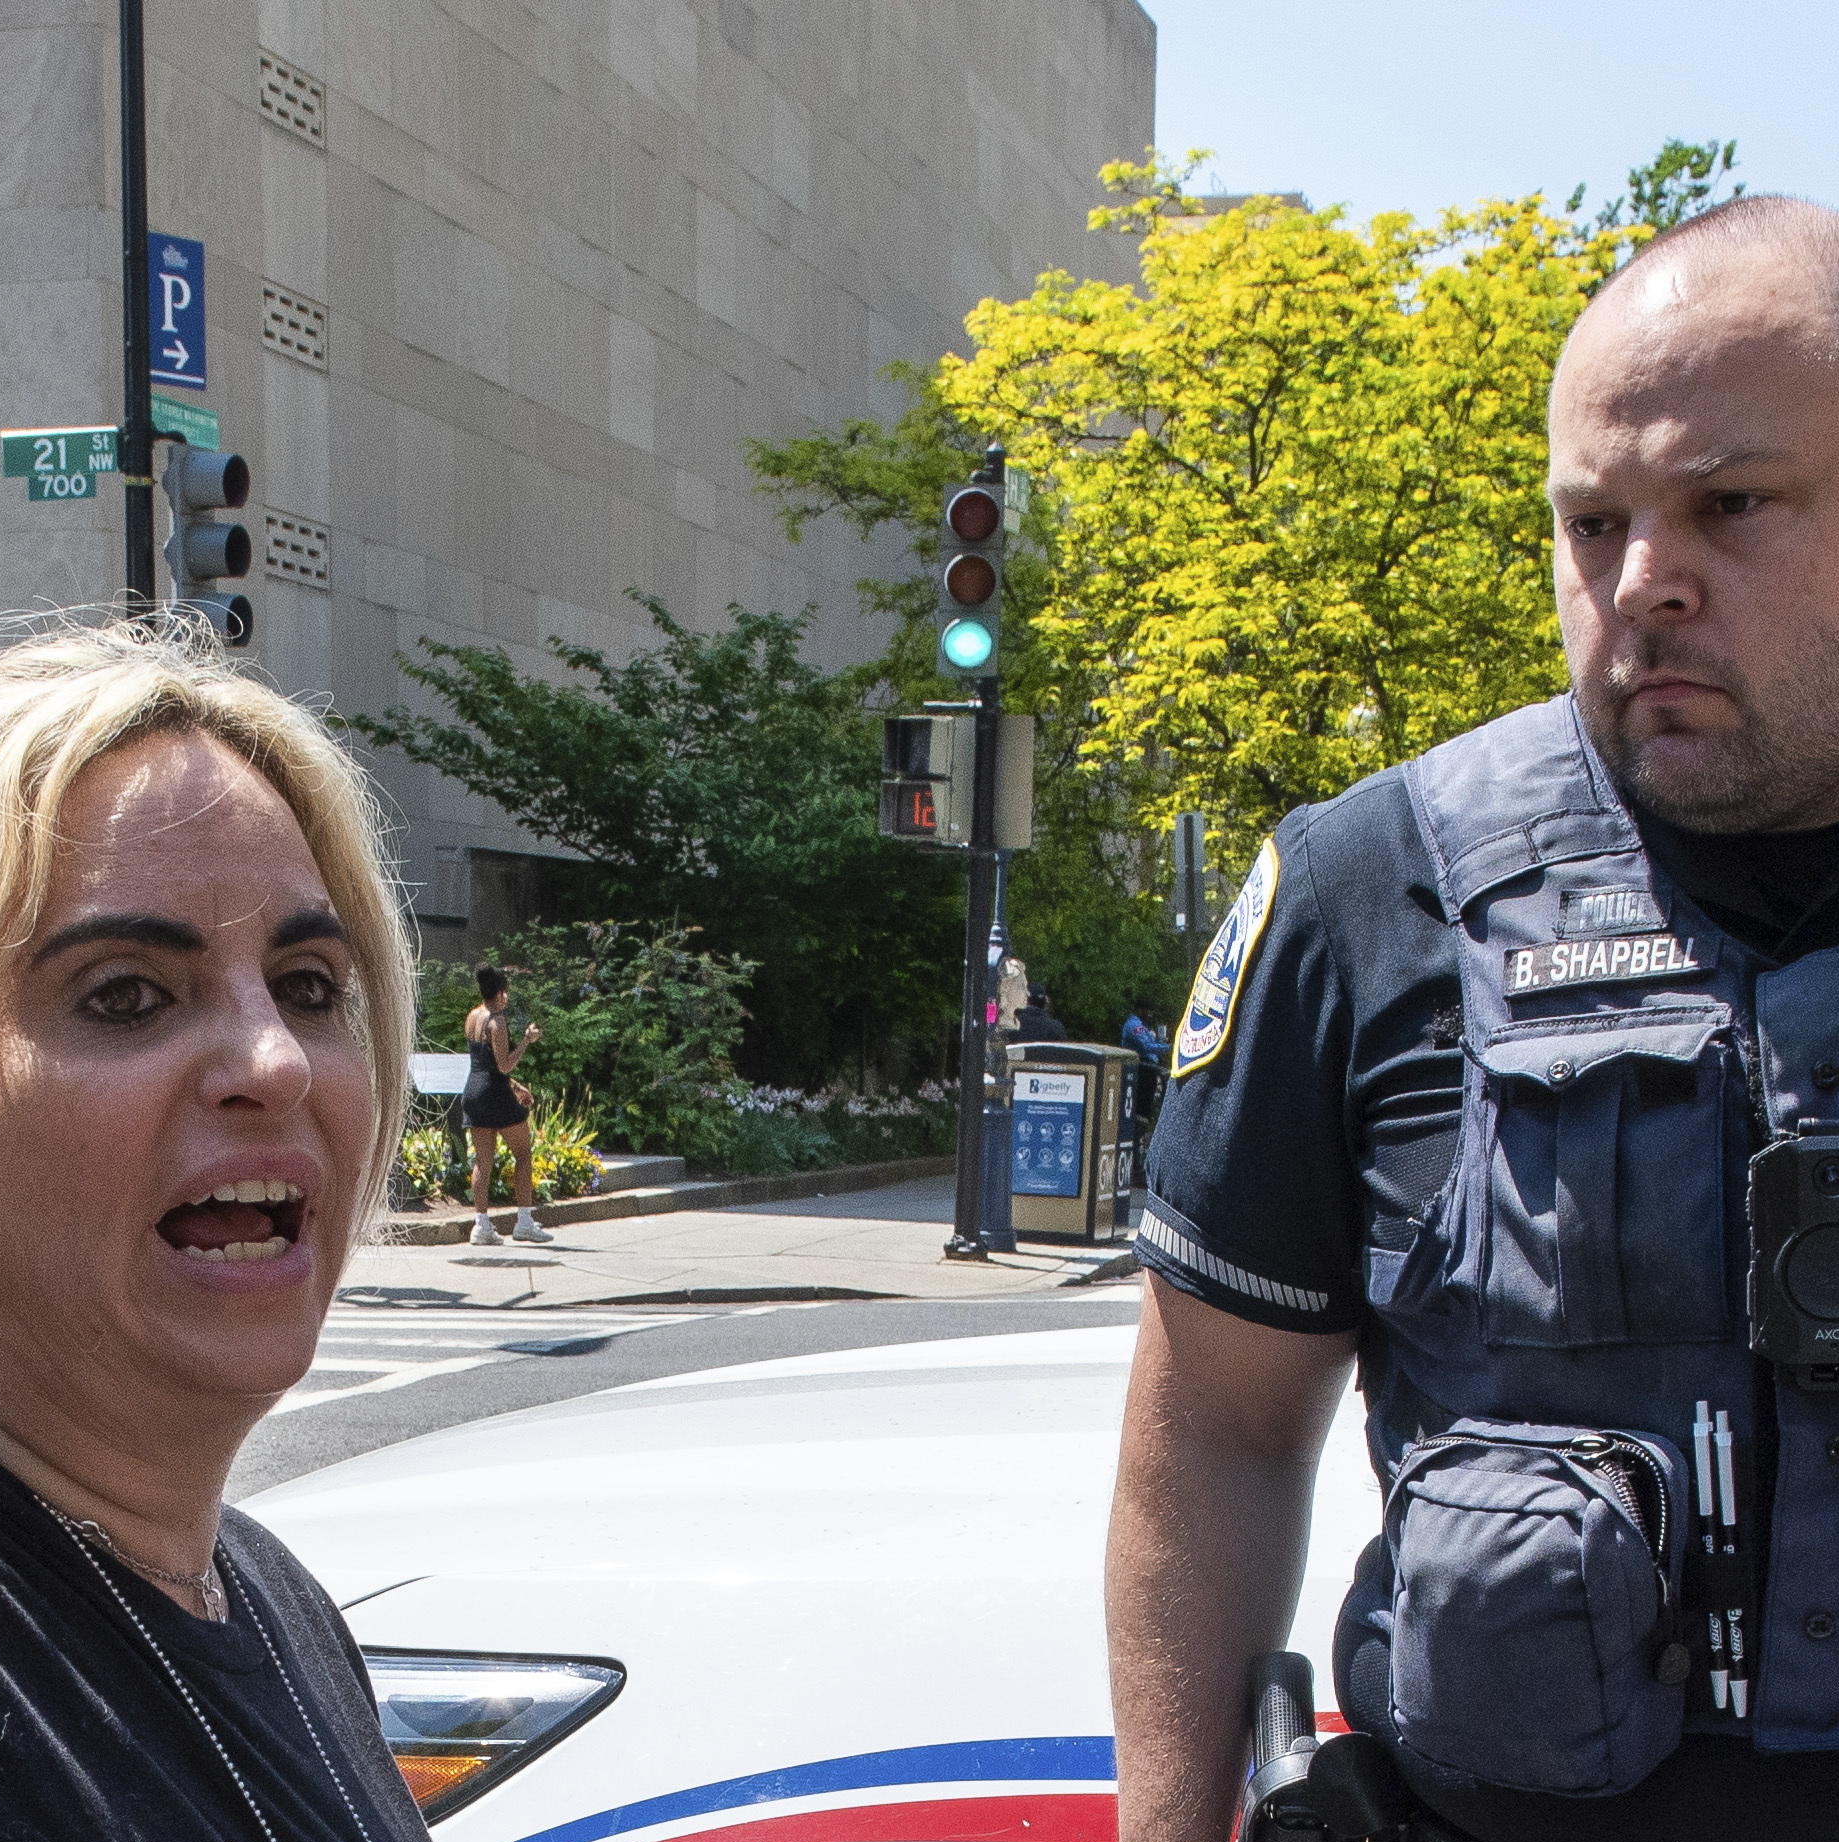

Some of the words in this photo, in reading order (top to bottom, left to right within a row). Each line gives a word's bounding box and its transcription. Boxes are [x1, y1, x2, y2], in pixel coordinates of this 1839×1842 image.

[159, 272, 192, 333] P
[34, 438, 67, 471] 21
[92, 435, 109, 450] St
[88, 454, 113, 472] NW
[37, 475, 87, 497] 700
[1514, 949, 1539, 989] B.
[1549, 936, 1699, 982] SHAPBELL
[1029, 1078, 1072, 1094] Bigbelly
